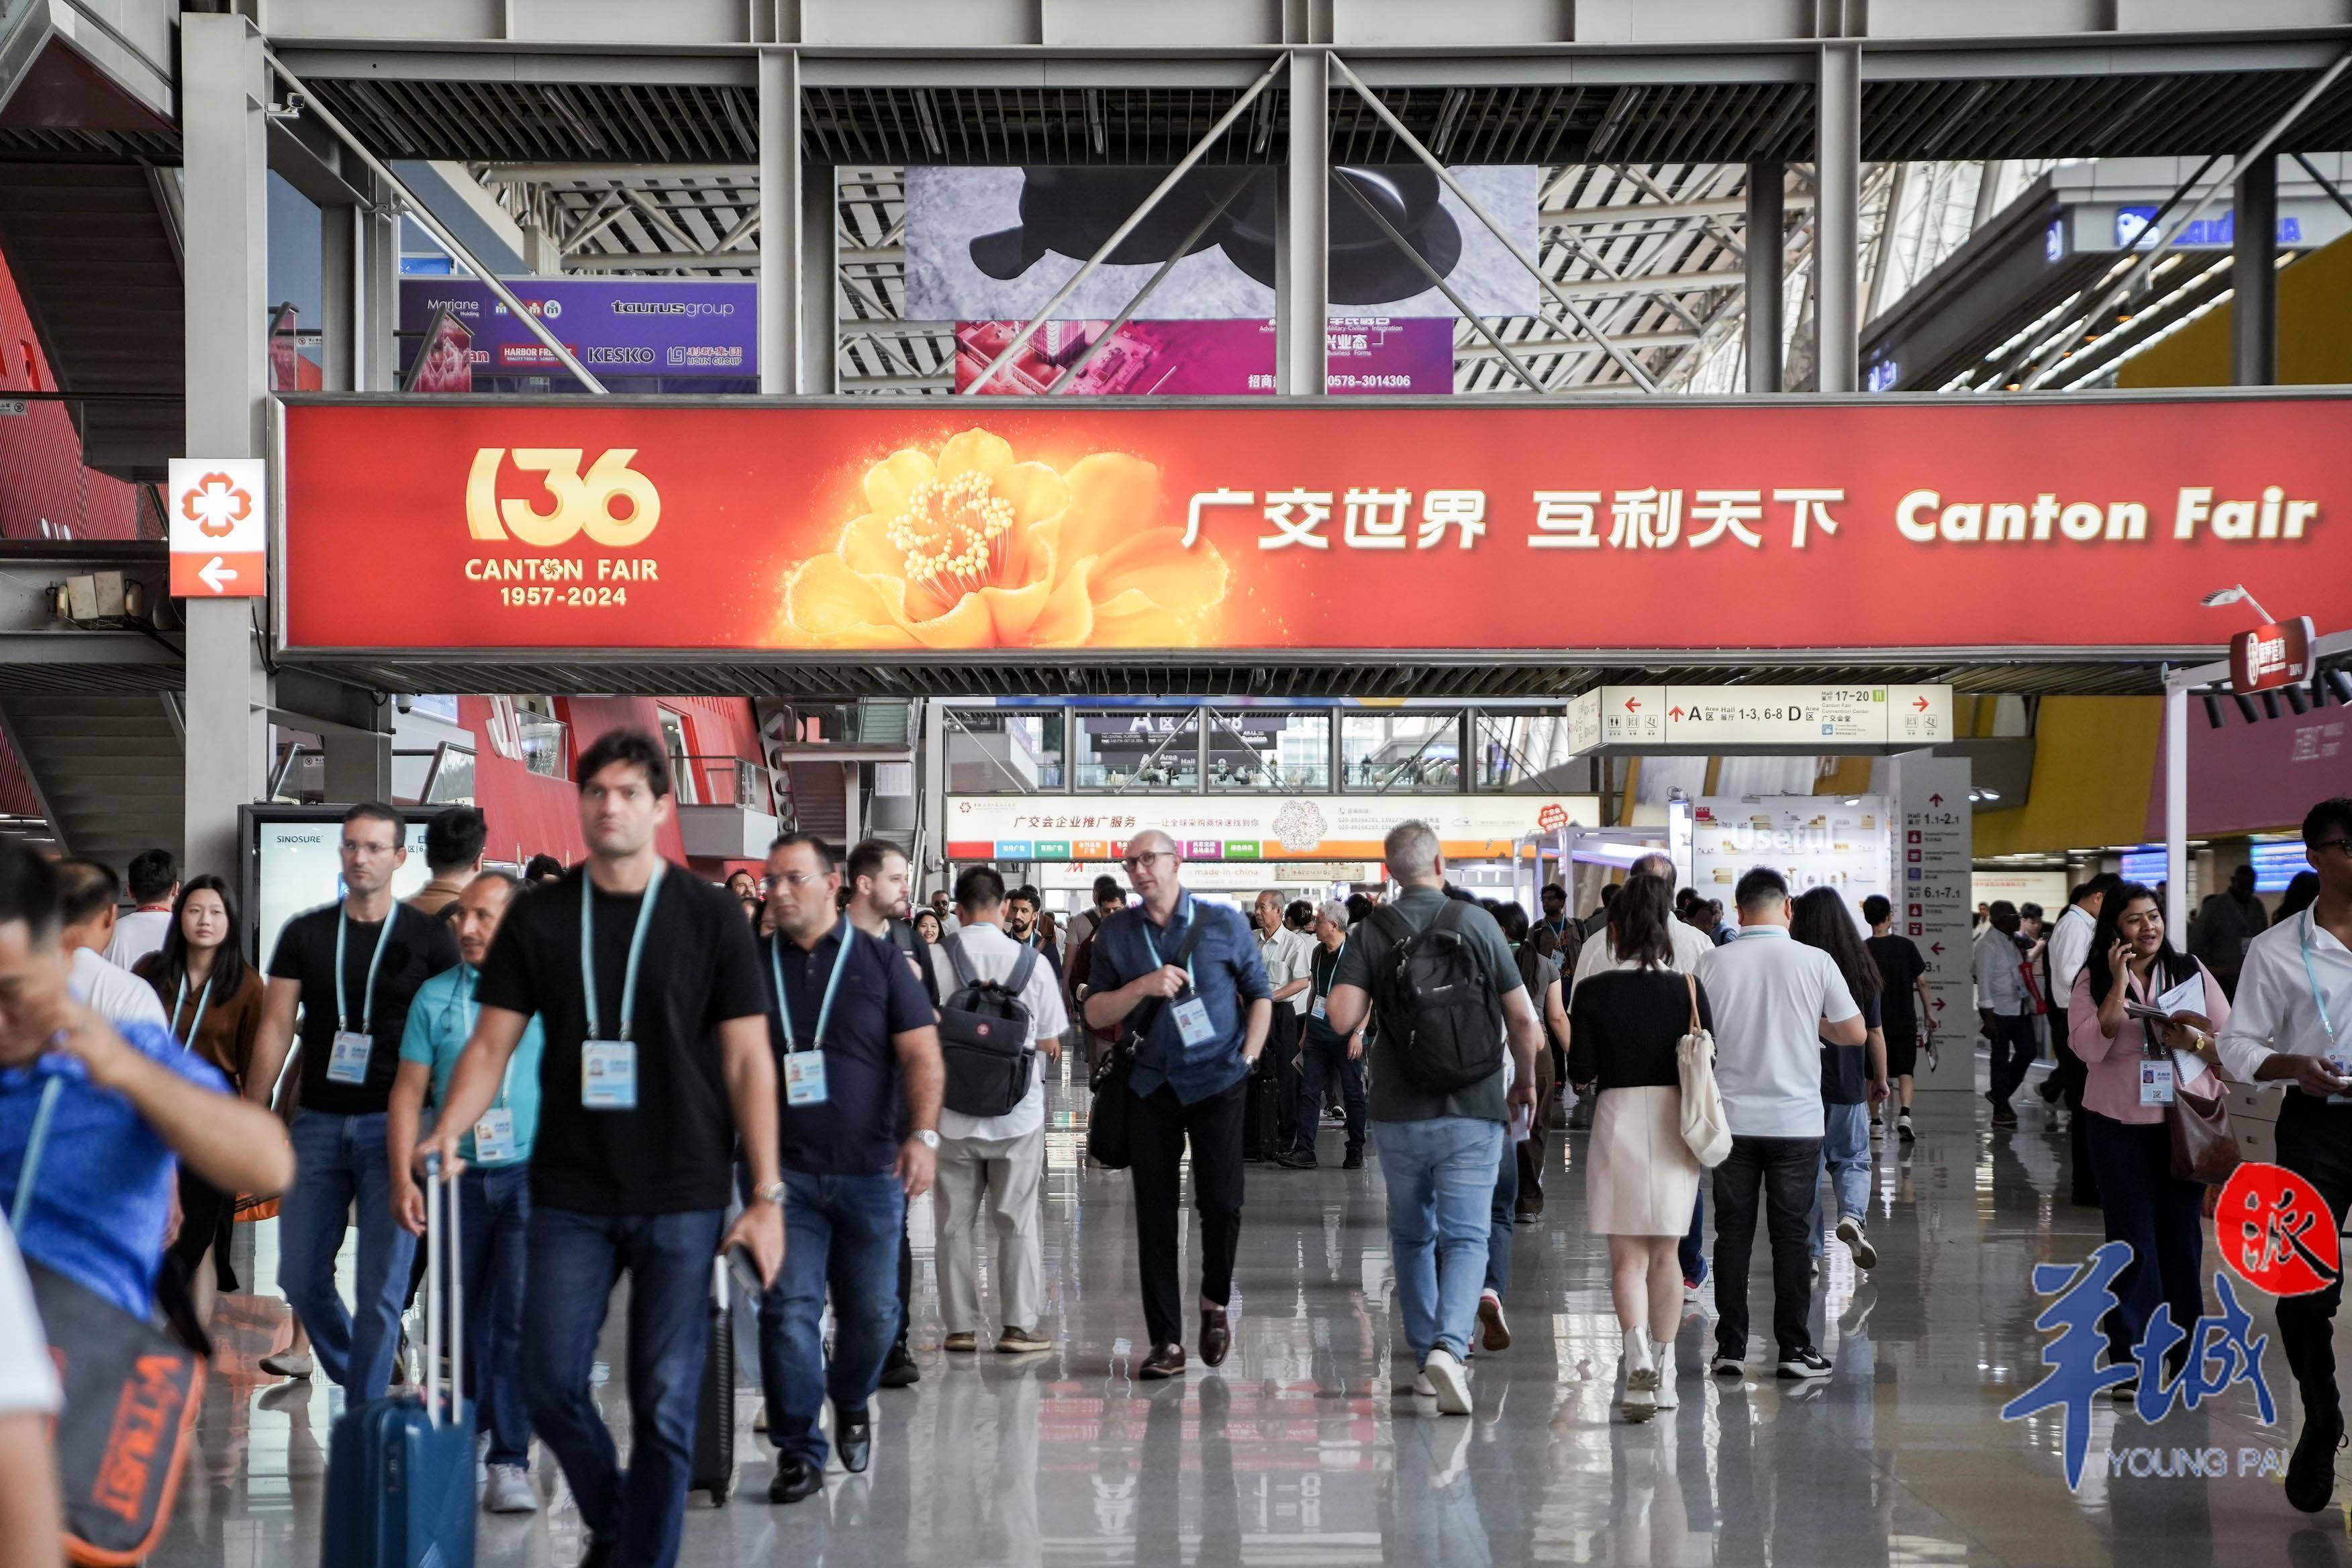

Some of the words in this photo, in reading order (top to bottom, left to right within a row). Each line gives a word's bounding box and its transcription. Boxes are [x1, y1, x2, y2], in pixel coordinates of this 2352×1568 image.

[611, 300, 734, 317] taurusgroup
[504, 348, 537, 356] HARBOR
[588, 347, 654, 363] KESKO
[687, 357, 711, 365] LIQUN
[712, 357, 742, 365] GROUP
[1327, 375, 1411, 387] 0578-3014306
[466, 448, 660, 547] 136
[1181, 487, 1486, 549] 广交世界
[1528, 485, 1845, 548] 互利天下
[1895, 488, 2148, 541] Canton
[2174, 486, 2318, 540] Fair
[597, 558, 659, 580] FAIR
[500, 587, 627, 605] 1957-2024
[1836, 691, 1869, 701] 17-20
[1688, 705, 1702, 721] A
[1764, 708, 1783, 720] 6-8
[1788, 705, 1802, 721] D
[1706, 712, 1714, 721] 区
[1806, 712, 1814, 721] 区
[1014, 815, 1136, 828] 广交会企业推广服务
[1924, 814, 1959, 824] 1.1-2.1
[277, 835, 322, 843] SINOSURE
[1730, 822, 1834, 850] Useful
[1924, 887, 1960, 898] 6.1-7.1
